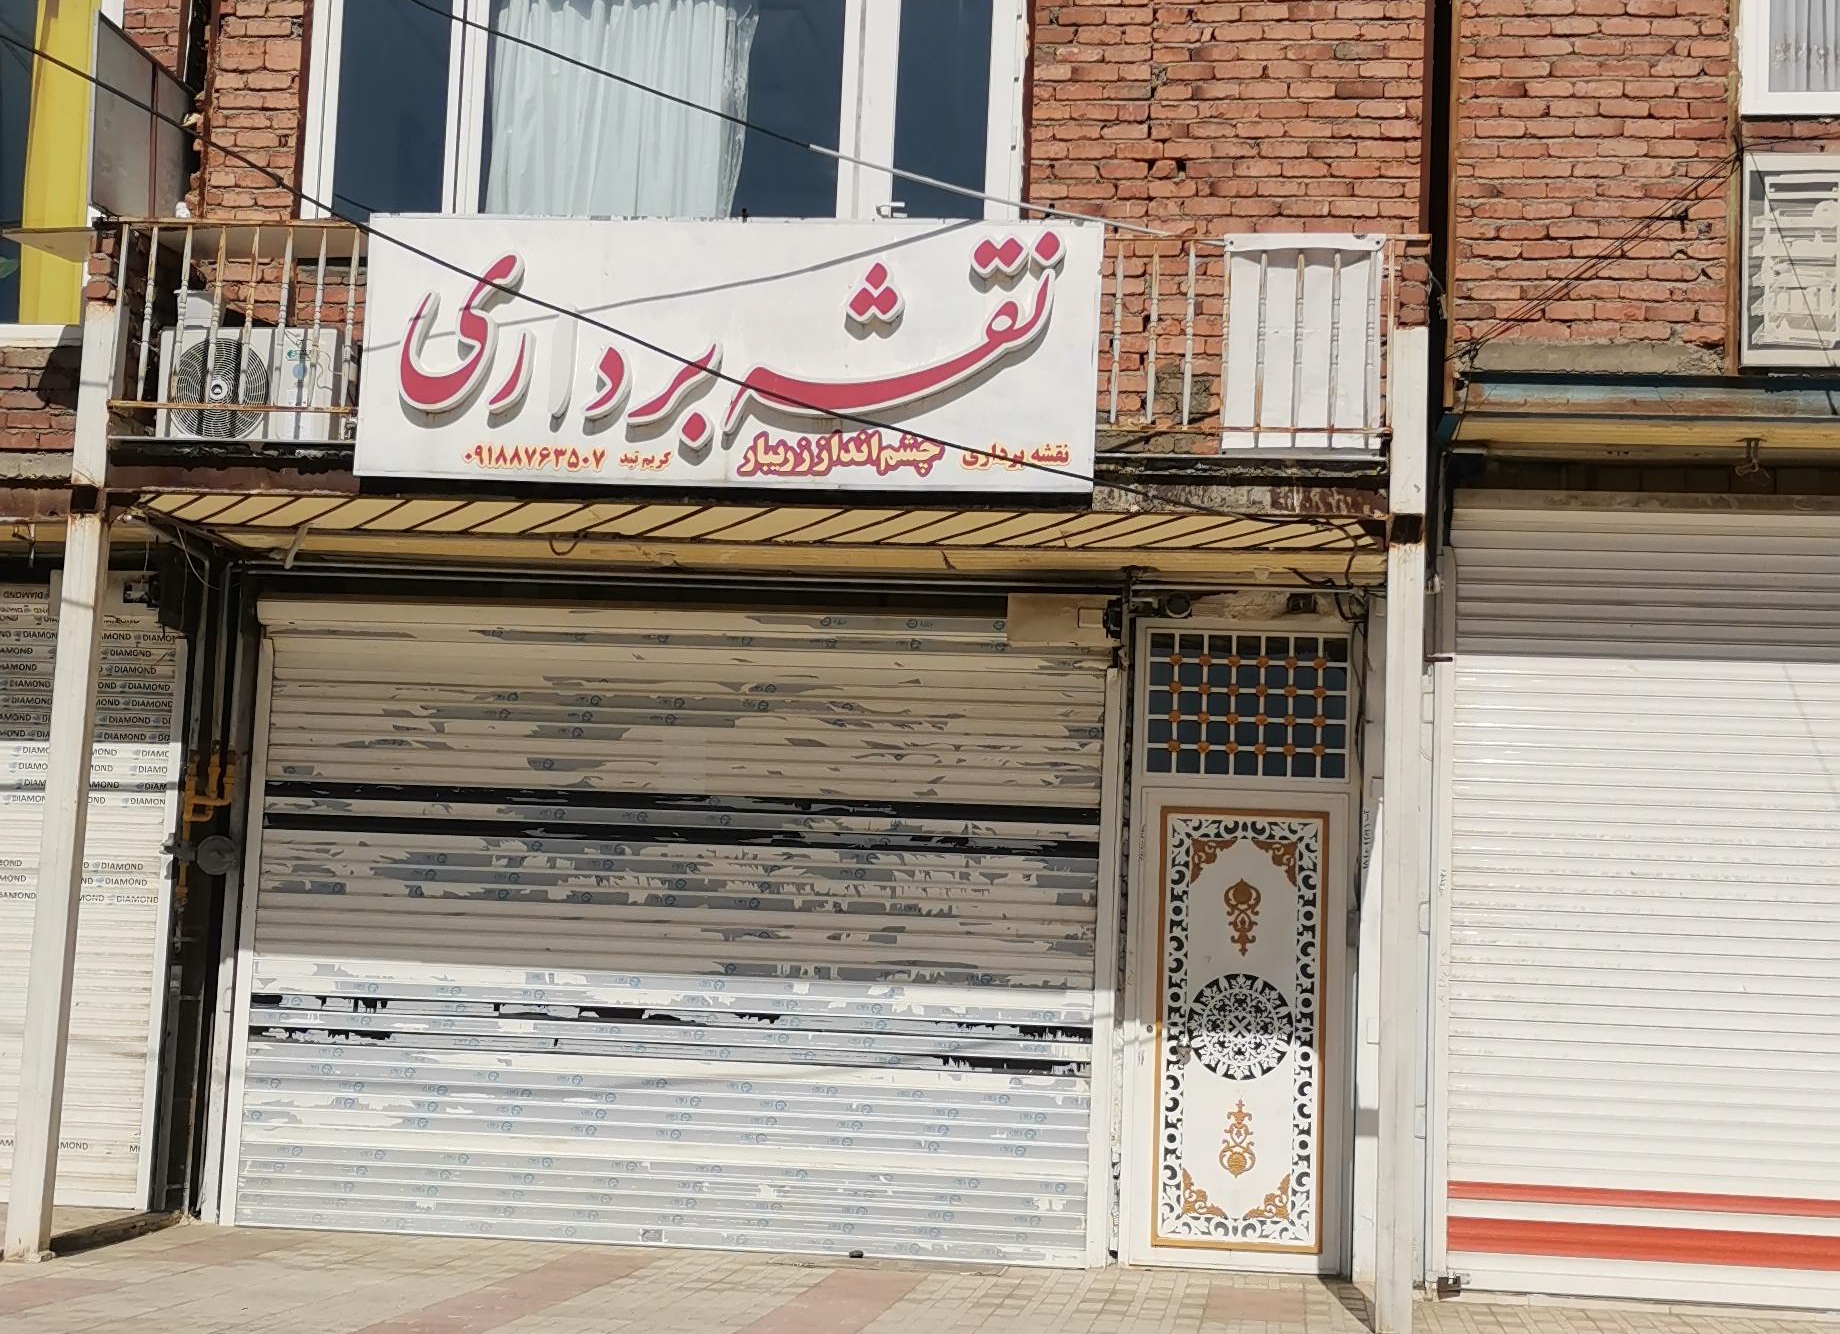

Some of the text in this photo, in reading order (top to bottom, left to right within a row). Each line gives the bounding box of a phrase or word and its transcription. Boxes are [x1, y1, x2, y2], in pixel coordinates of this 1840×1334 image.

[398, 229, 1067, 447] نقشه برداری
[465, 444, 606, 469] ۰۹۱۸۸۷۶۳۵۰۷
[740, 434, 811, 472] زریبار
[962, 442, 1070, 469] نقشه برداری
[110, 649, 152, 658] DIAMOND
[114, 666, 157, 675] DIAMOND
[9, 680, 50, 688] DIAMOND
[128, 682, 171, 692] DIAMOND
[109, 716, 151, 725] DIAMOND
[103, 732, 147, 741] DIAMOND
[101, 861, 144, 871] DIAMOND
[105, 877, 148, 887] DIAMOND
